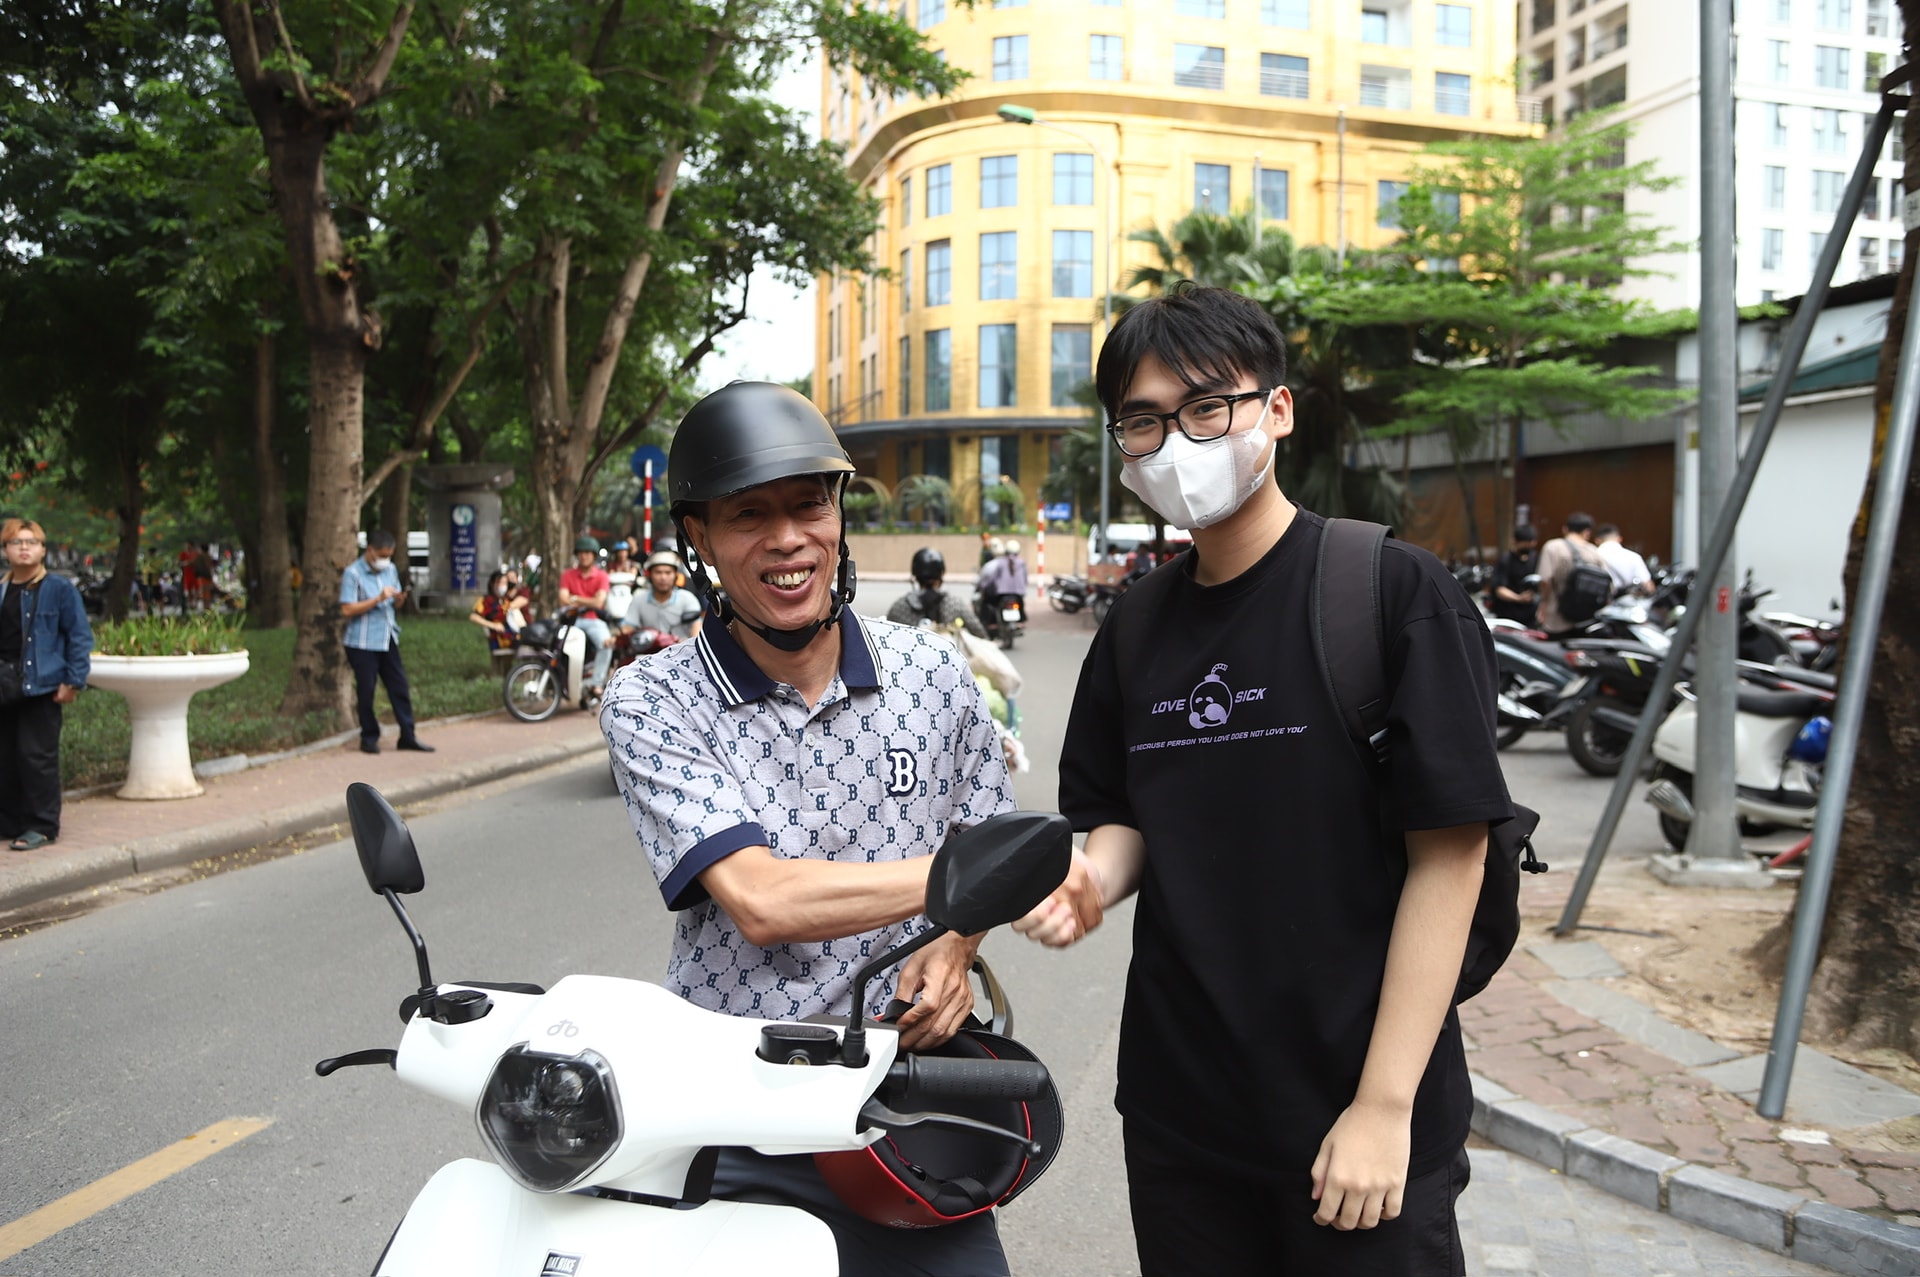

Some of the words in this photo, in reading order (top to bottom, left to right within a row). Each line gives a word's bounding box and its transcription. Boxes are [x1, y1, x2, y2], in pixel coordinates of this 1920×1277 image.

[1152, 699, 1186, 714] LOVE
[1234, 687, 1267, 704] SICK
[1136, 741, 1166, 752] BECAUSE
[1166, 738, 1197, 748] PERSON
[1198, 736, 1213, 744] YOU
[1213, 734, 1231, 743] LOVE
[1230, 731, 1249, 741] DOES
[1249, 729, 1265, 738] NOT
[1265, 727, 1286, 736] LOVE
[887, 748, 918, 797] B
